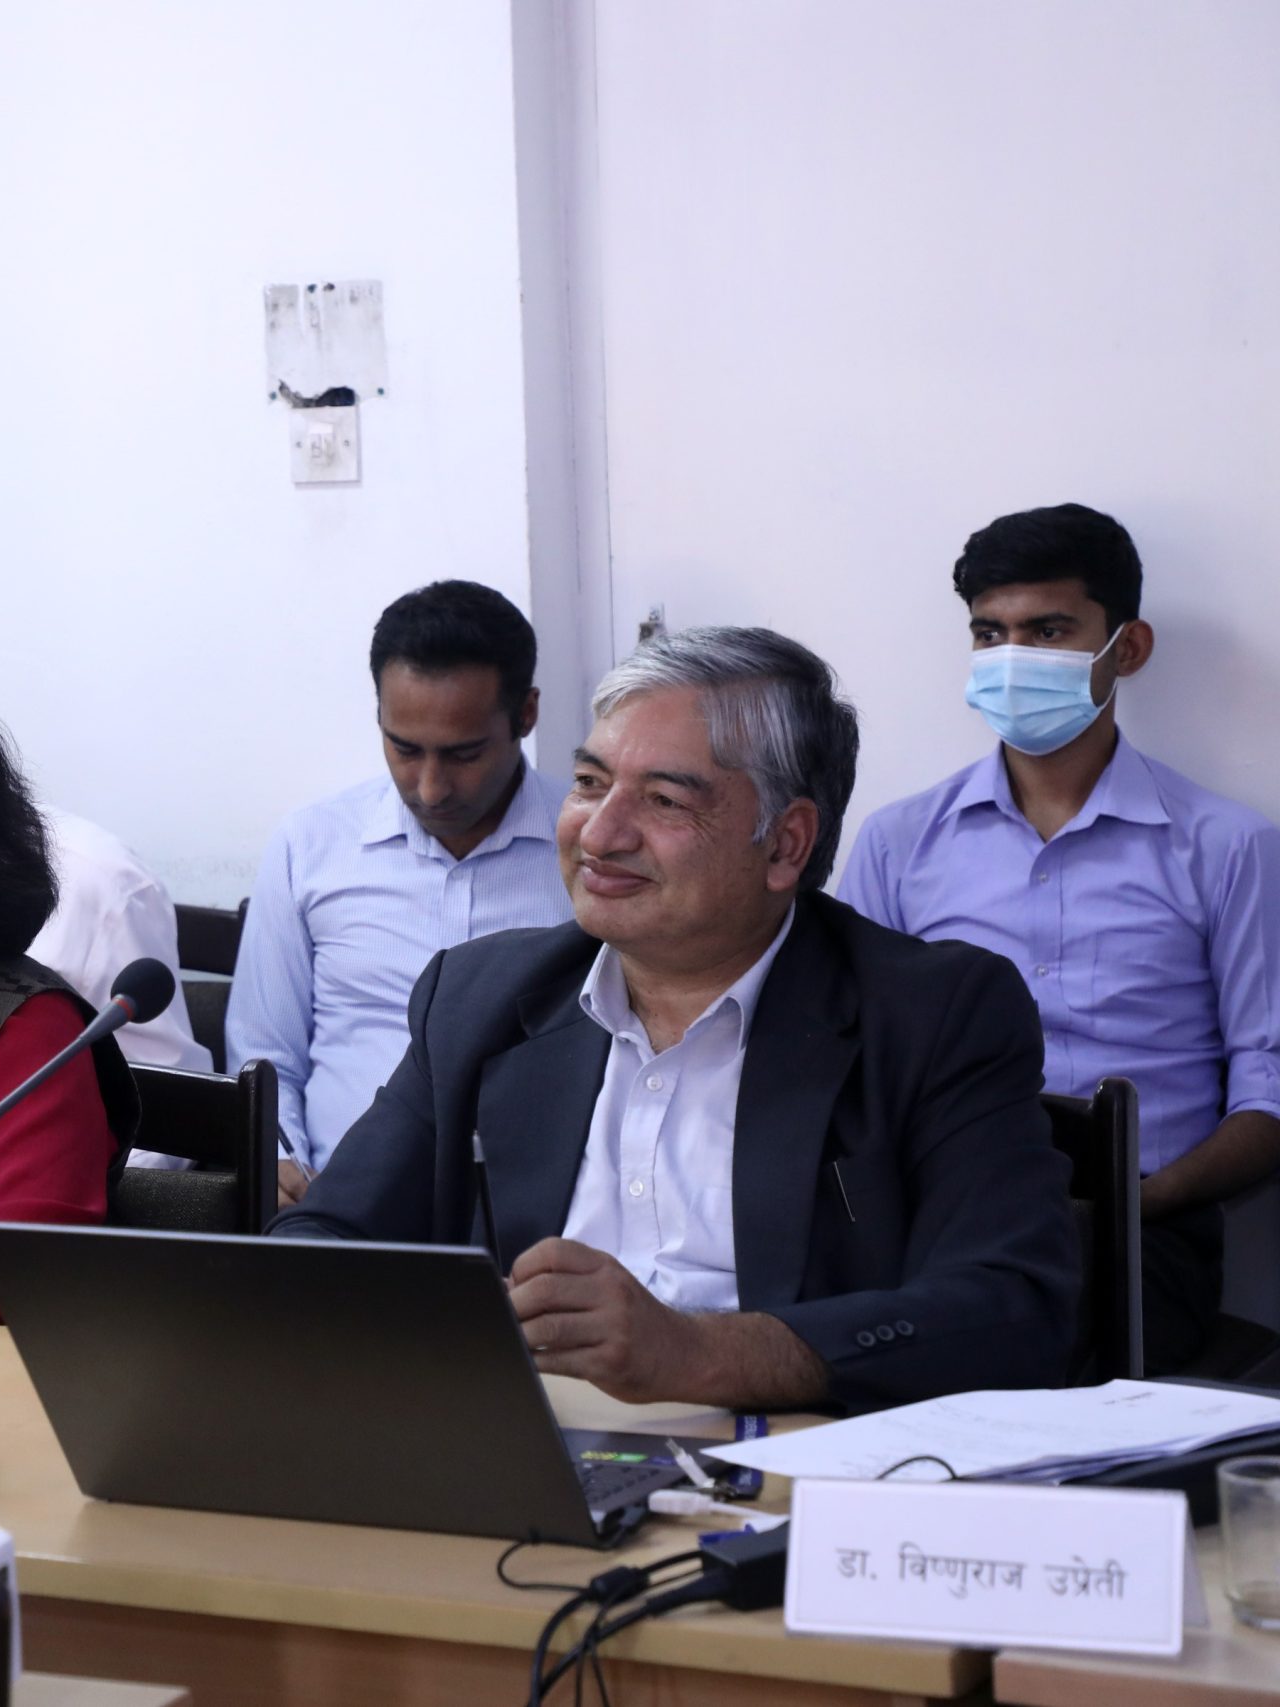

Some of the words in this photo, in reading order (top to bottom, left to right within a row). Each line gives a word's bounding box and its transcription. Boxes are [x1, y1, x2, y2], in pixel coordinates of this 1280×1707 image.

[835, 1547, 878, 1580] डा.
[898, 1542, 1027, 1599] विष्णुराज
[1043, 1556, 1130, 1599] उप्रेती
